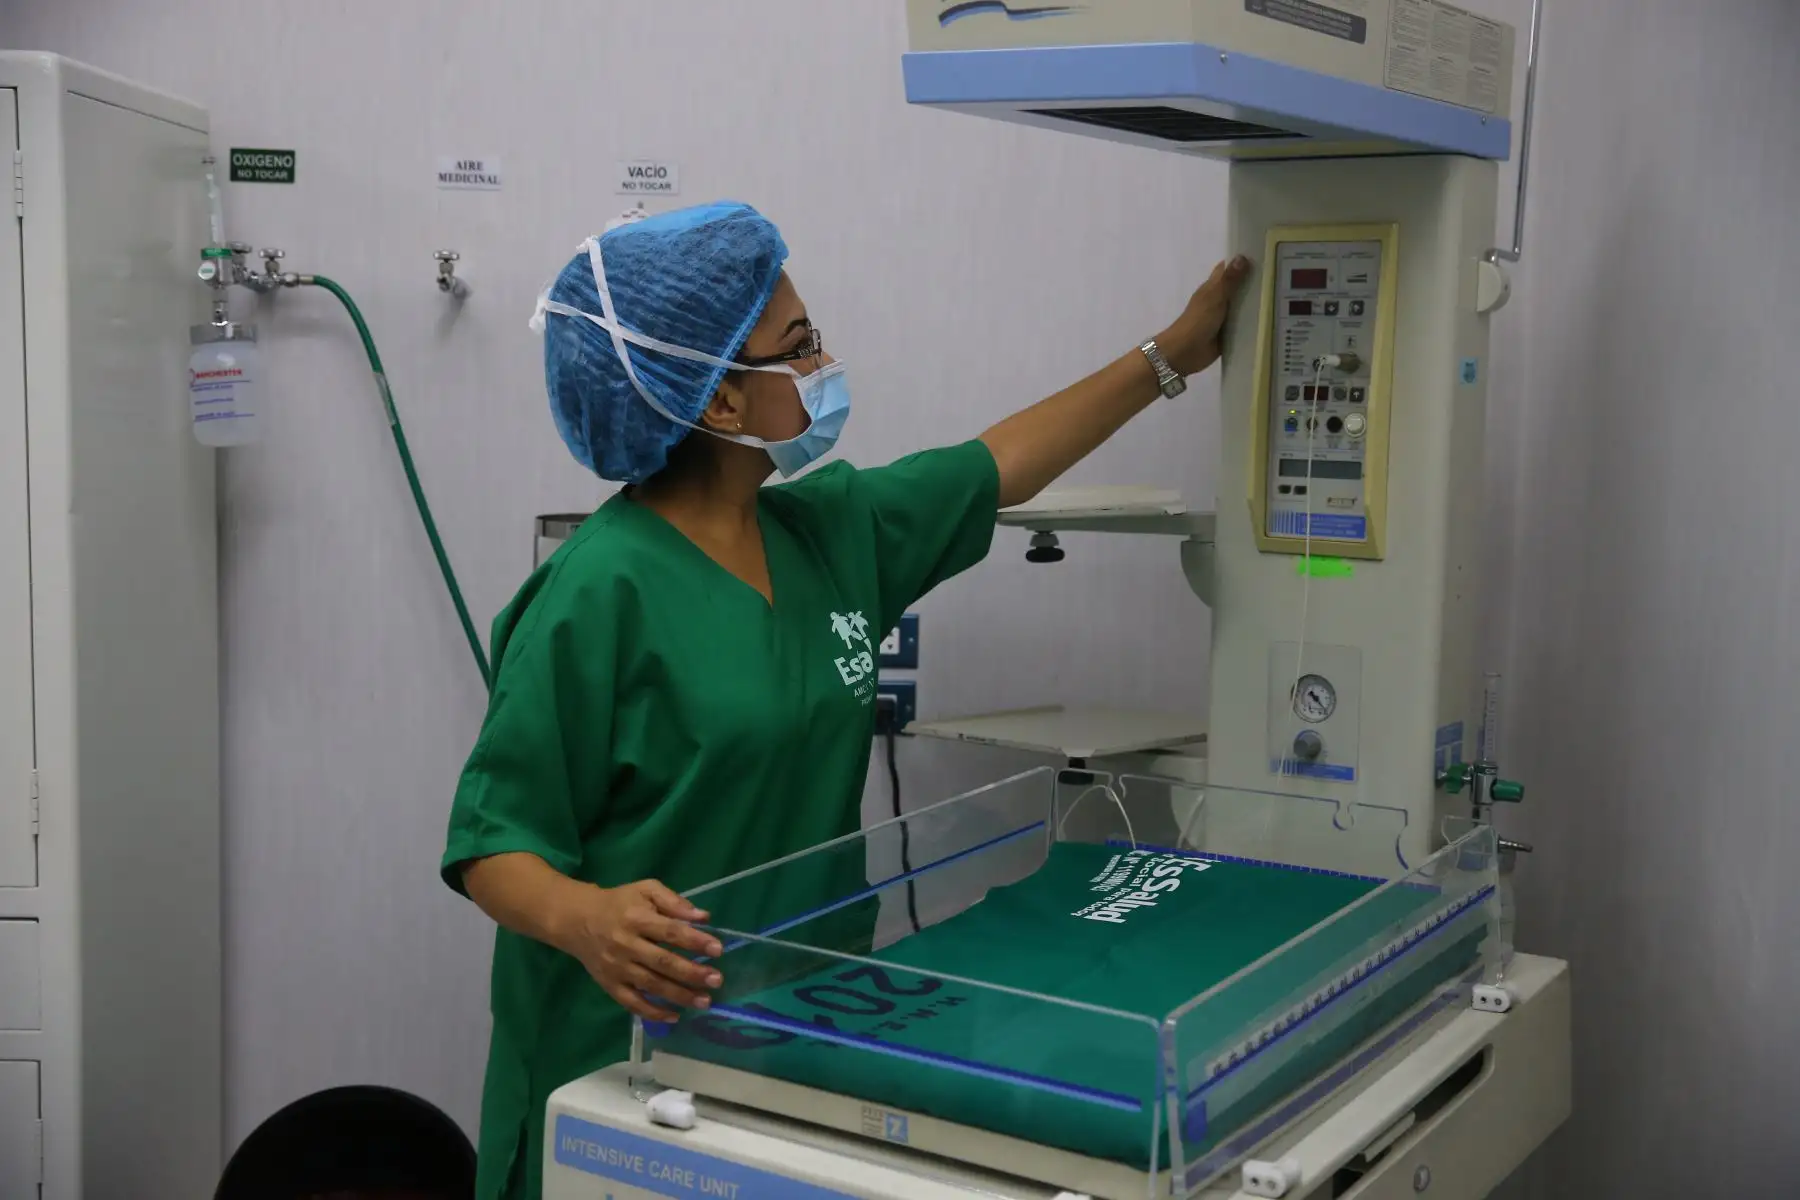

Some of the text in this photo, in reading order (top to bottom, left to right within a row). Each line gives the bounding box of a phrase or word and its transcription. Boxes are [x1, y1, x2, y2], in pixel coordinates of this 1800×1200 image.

[232, 153, 294, 168] OXIGENO
[454, 160, 484, 172] AIRE
[237, 170, 288, 180] NO TOCAR
[438, 172, 501, 185] MEDICINAL
[622, 181, 672, 191] NO TOCAR
[1083, 857, 1213, 924] EsSalud
[561, 1134, 741, 1200] INTENSIVE CARE UNIT
